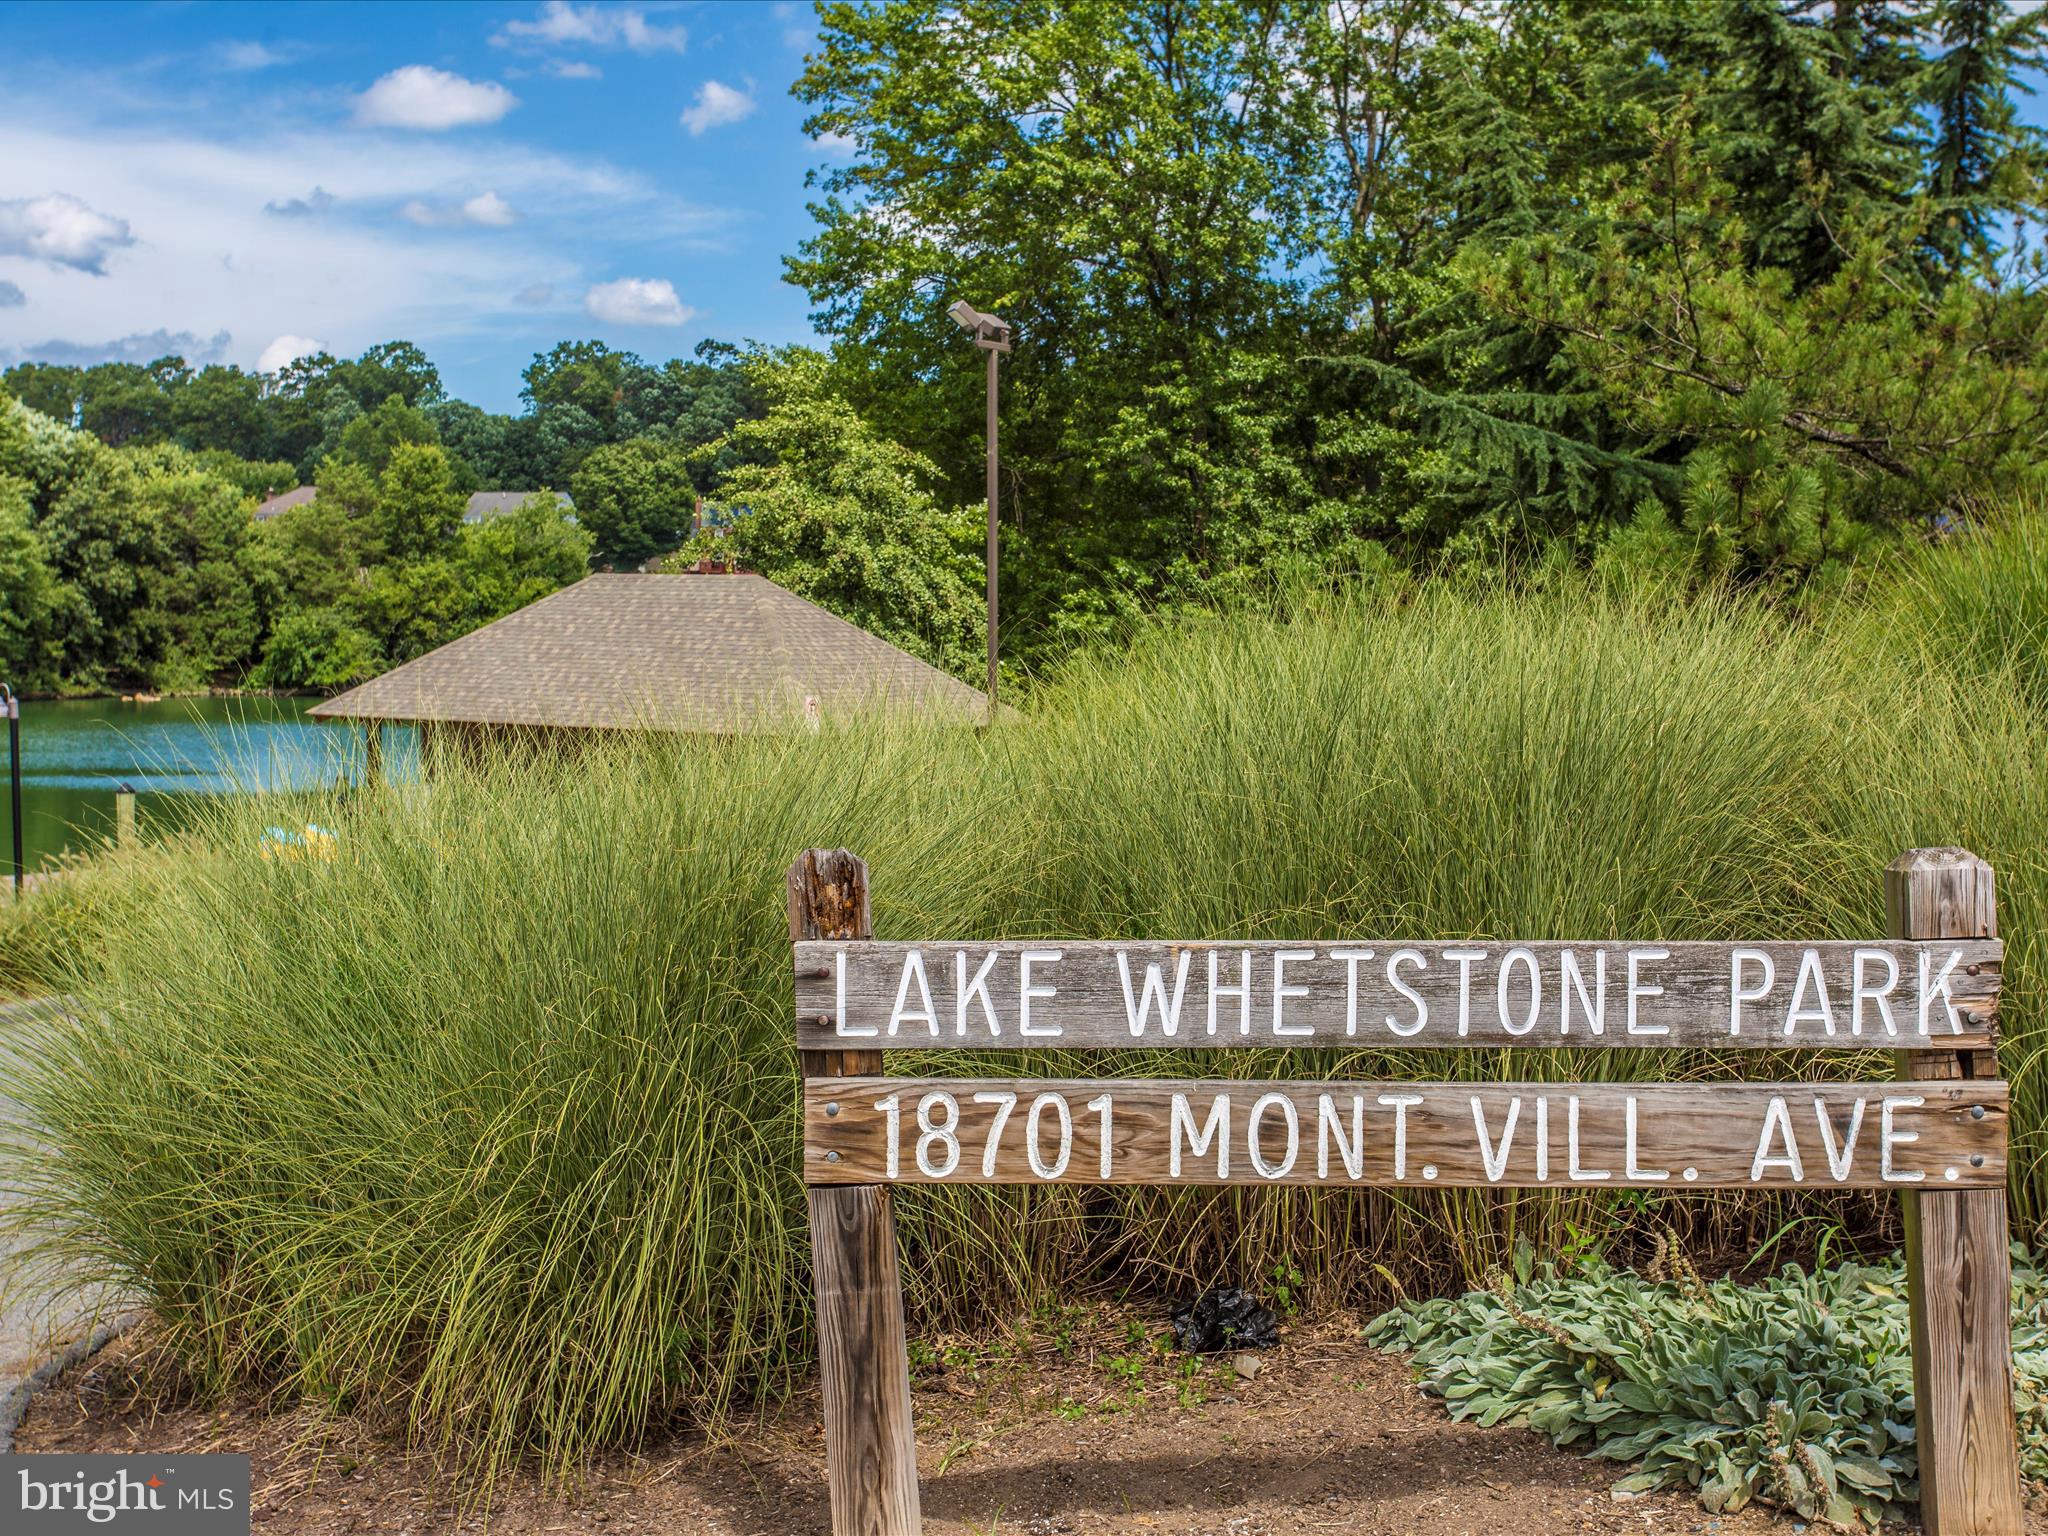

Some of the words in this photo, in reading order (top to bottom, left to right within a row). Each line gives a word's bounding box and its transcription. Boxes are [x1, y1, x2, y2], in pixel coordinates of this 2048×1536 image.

[835, 949, 1063, 1037] LAKE
[1116, 948, 1671, 1037] WHETSTONE
[1730, 948, 1964, 1037] PARK
[873, 1091, 1113, 1179] 18701
[1169, 1093, 1439, 1180] MONT.
[1470, 1096, 1699, 1182] VILL.
[1750, 1096, 1960, 1182] AVE.
